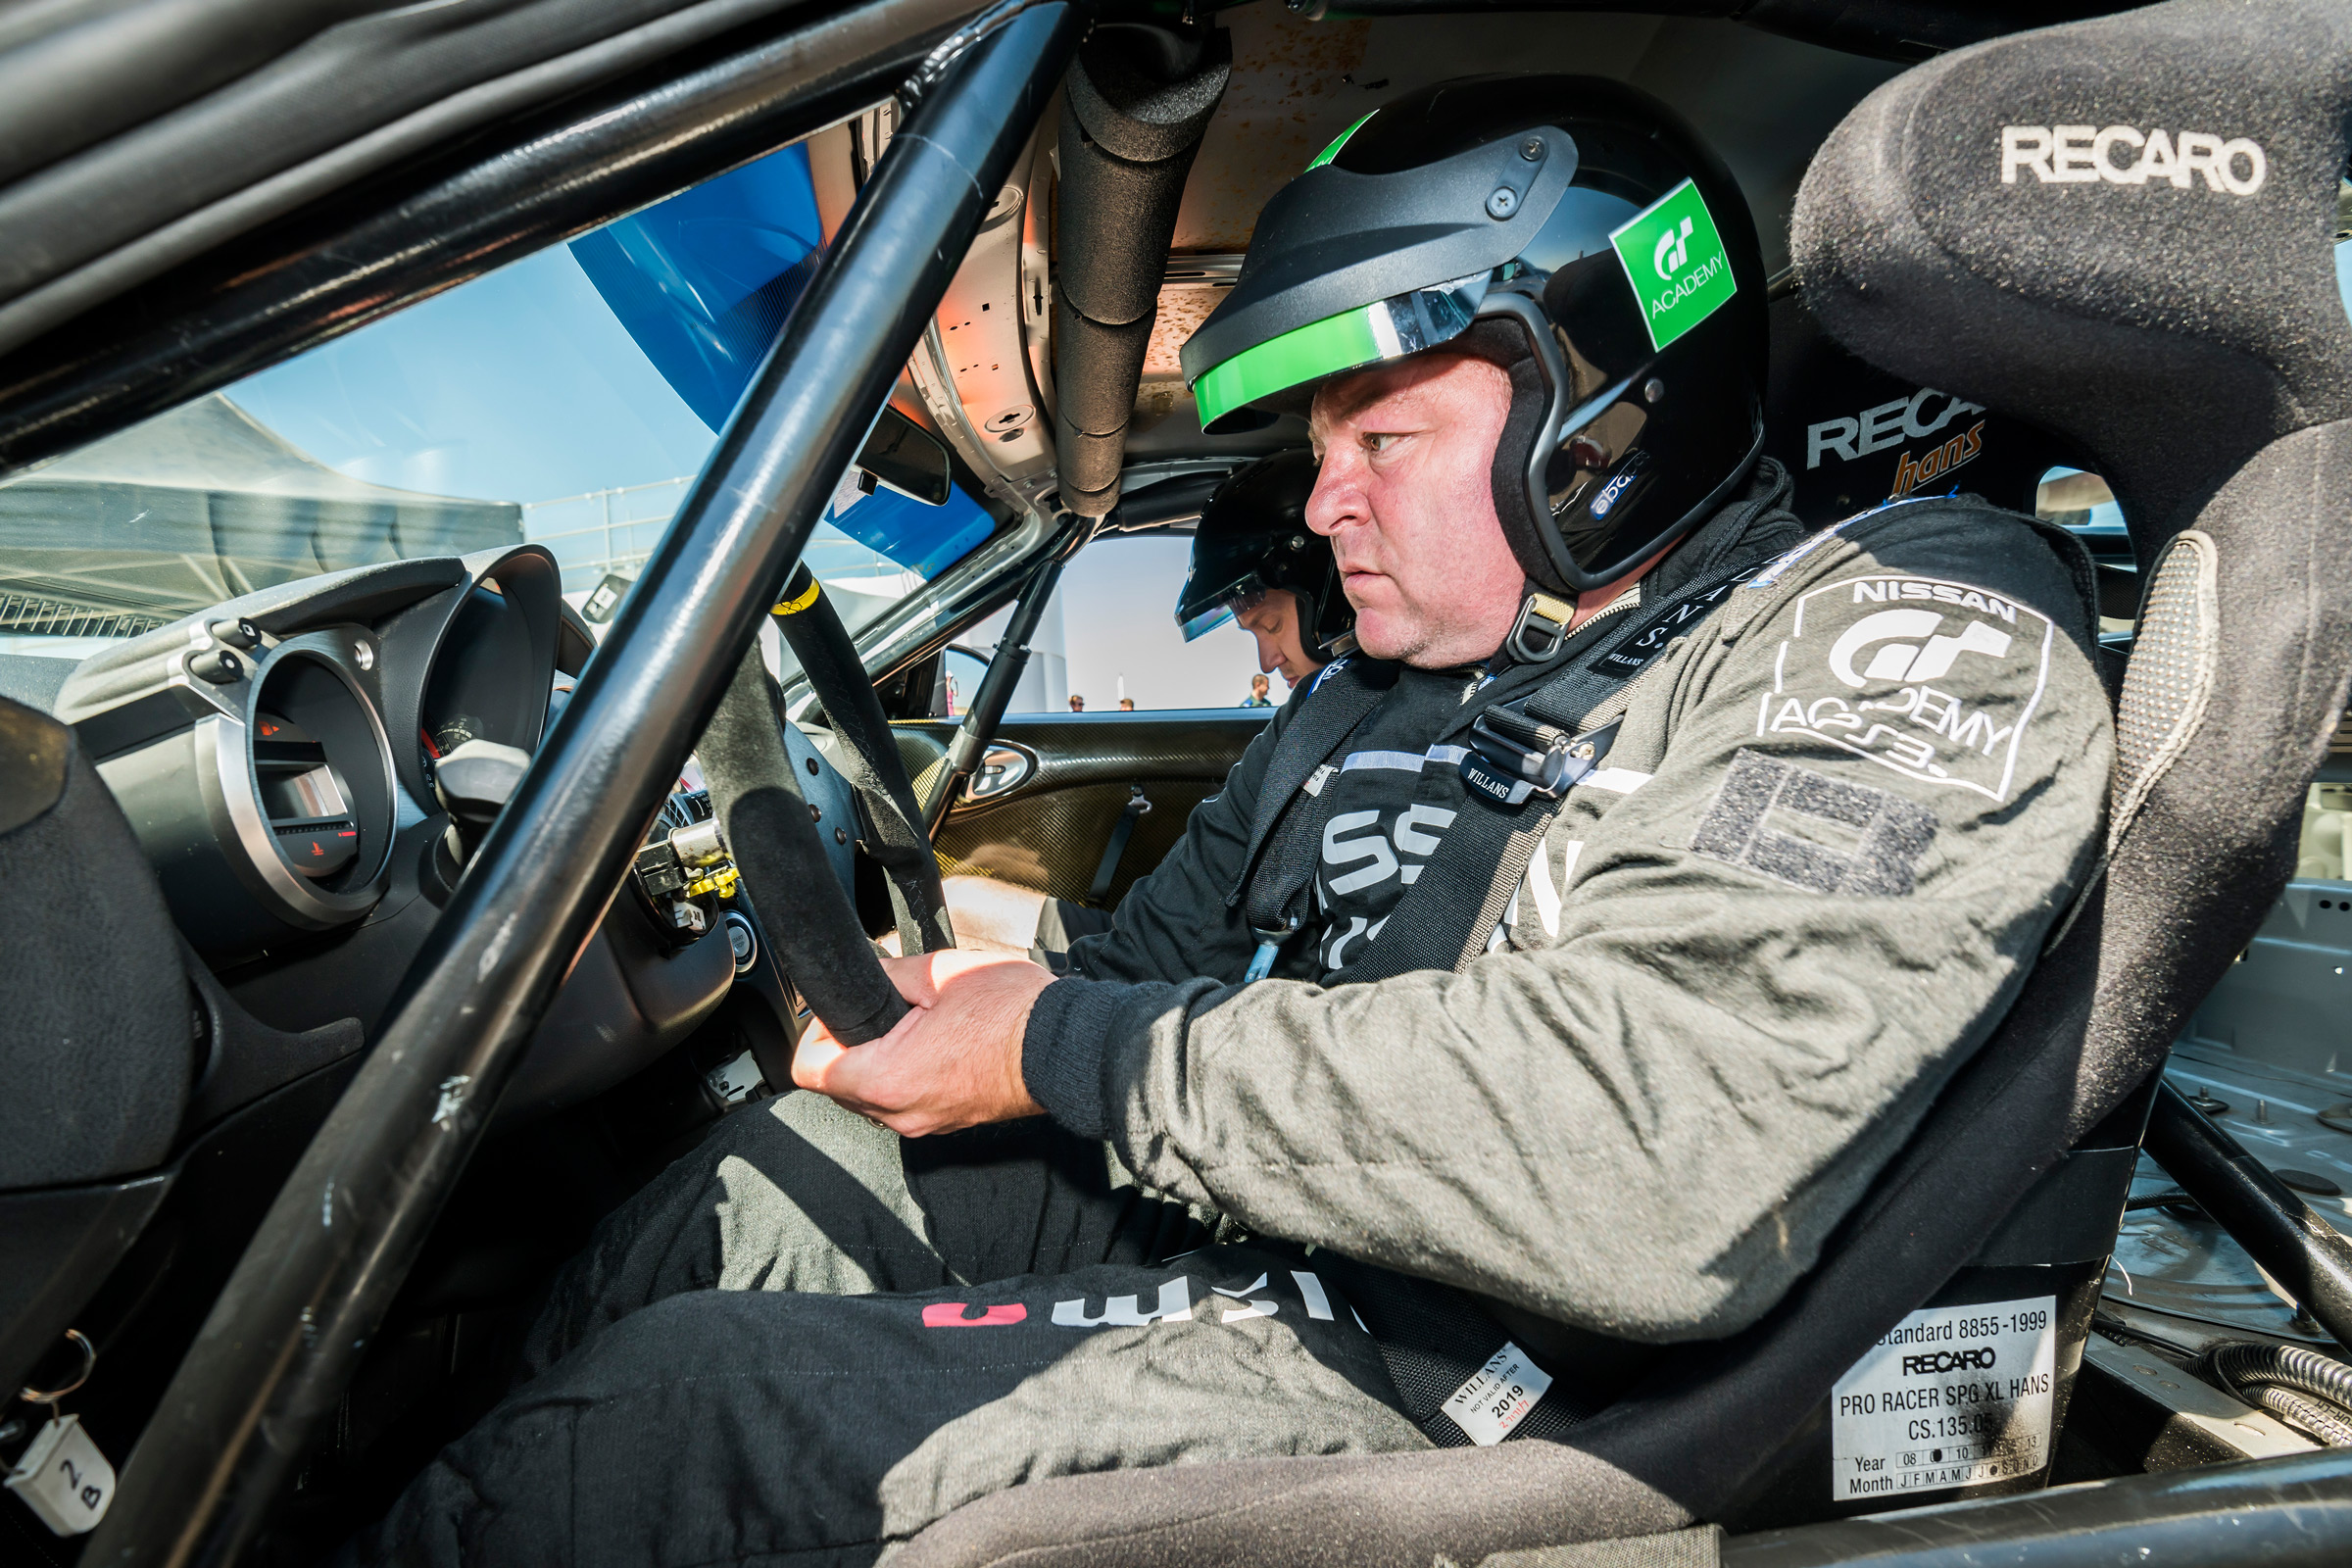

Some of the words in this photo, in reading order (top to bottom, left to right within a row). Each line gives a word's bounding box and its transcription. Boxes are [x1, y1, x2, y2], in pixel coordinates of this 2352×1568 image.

[2001, 124, 2266, 195] RECARO
[1652, 251, 1723, 319] ACADEMY
[1891, 419, 1985, 495] hans
[1853, 581, 2016, 623] NISSAN
[1608, 653, 1643, 666] WILLANS
[1467, 767, 1510, 799] WILLANS
[1454, 1351, 1507, 1404] WILLANS
[1902, 1347, 1996, 1376] RECARO
[1470, 1400, 1484, 1414] NOT
[1483, 1383, 1501, 1402] VALID
[1499, 1363, 1520, 1384] AFTER
[1492, 1385, 1524, 1418] 2019
[1840, 1394, 1876, 1416] PRO
[1883, 1388, 1939, 1412] RACER
[1945, 1383, 1980, 1405] SPG
[1985, 1381, 2004, 1401] XL
[2009, 1373, 2049, 1399] HANS
[1855, 1456, 1886, 1472] Year
[1903, 1452, 1917, 1466] 08
[1956, 1446, 1969, 1459] 10
[2027, 1435, 2037, 1448] 13
[60, 1458, 81, 1490] 2
[1849, 1475, 1893, 1494] Month
[1900, 1474, 1907, 1488] J
[1914, 1473, 1920, 1486] F
[1925, 1471, 1935, 1484] M
[1940, 1470, 1947, 1483] A
[1951, 1468, 1961, 1481] M
[1966, 1467, 1972, 1480] J
[1979, 1465, 1984, 1478] J
